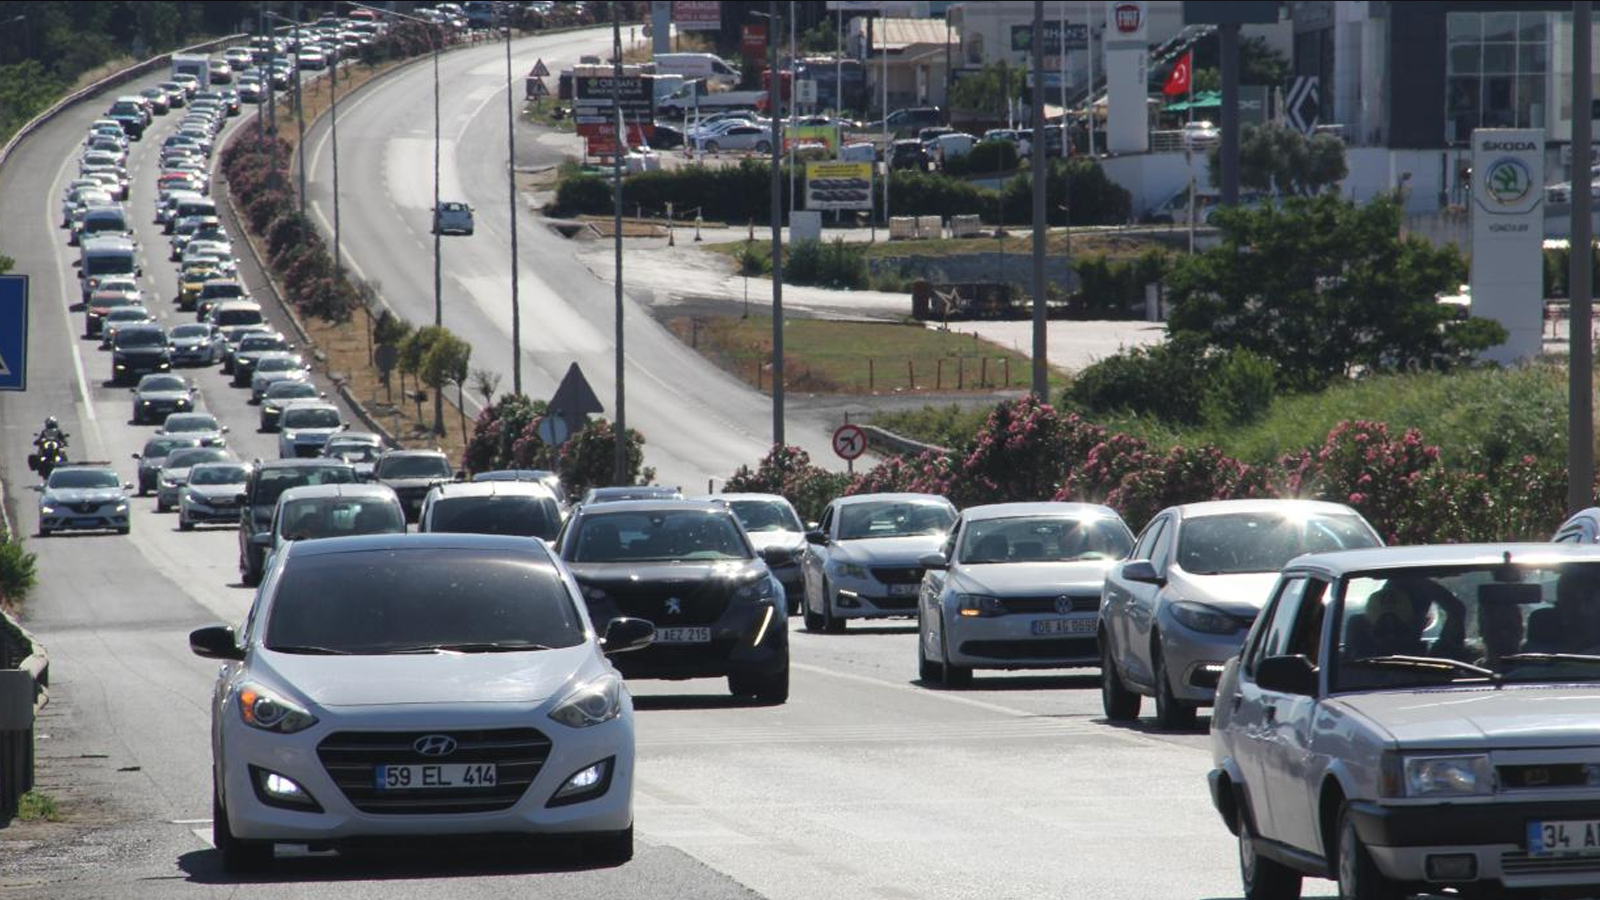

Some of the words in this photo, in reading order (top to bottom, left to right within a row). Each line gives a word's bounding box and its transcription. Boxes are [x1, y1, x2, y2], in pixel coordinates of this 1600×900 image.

[1118, 10, 1138, 27] FIAT
[688, 628, 708, 640] 215
[386, 767, 411, 786] 59
[422, 766, 452, 785] EL
[463, 765, 494, 784] 414
[1544, 824, 1570, 848] 34
[1584, 823, 1600, 847] A
